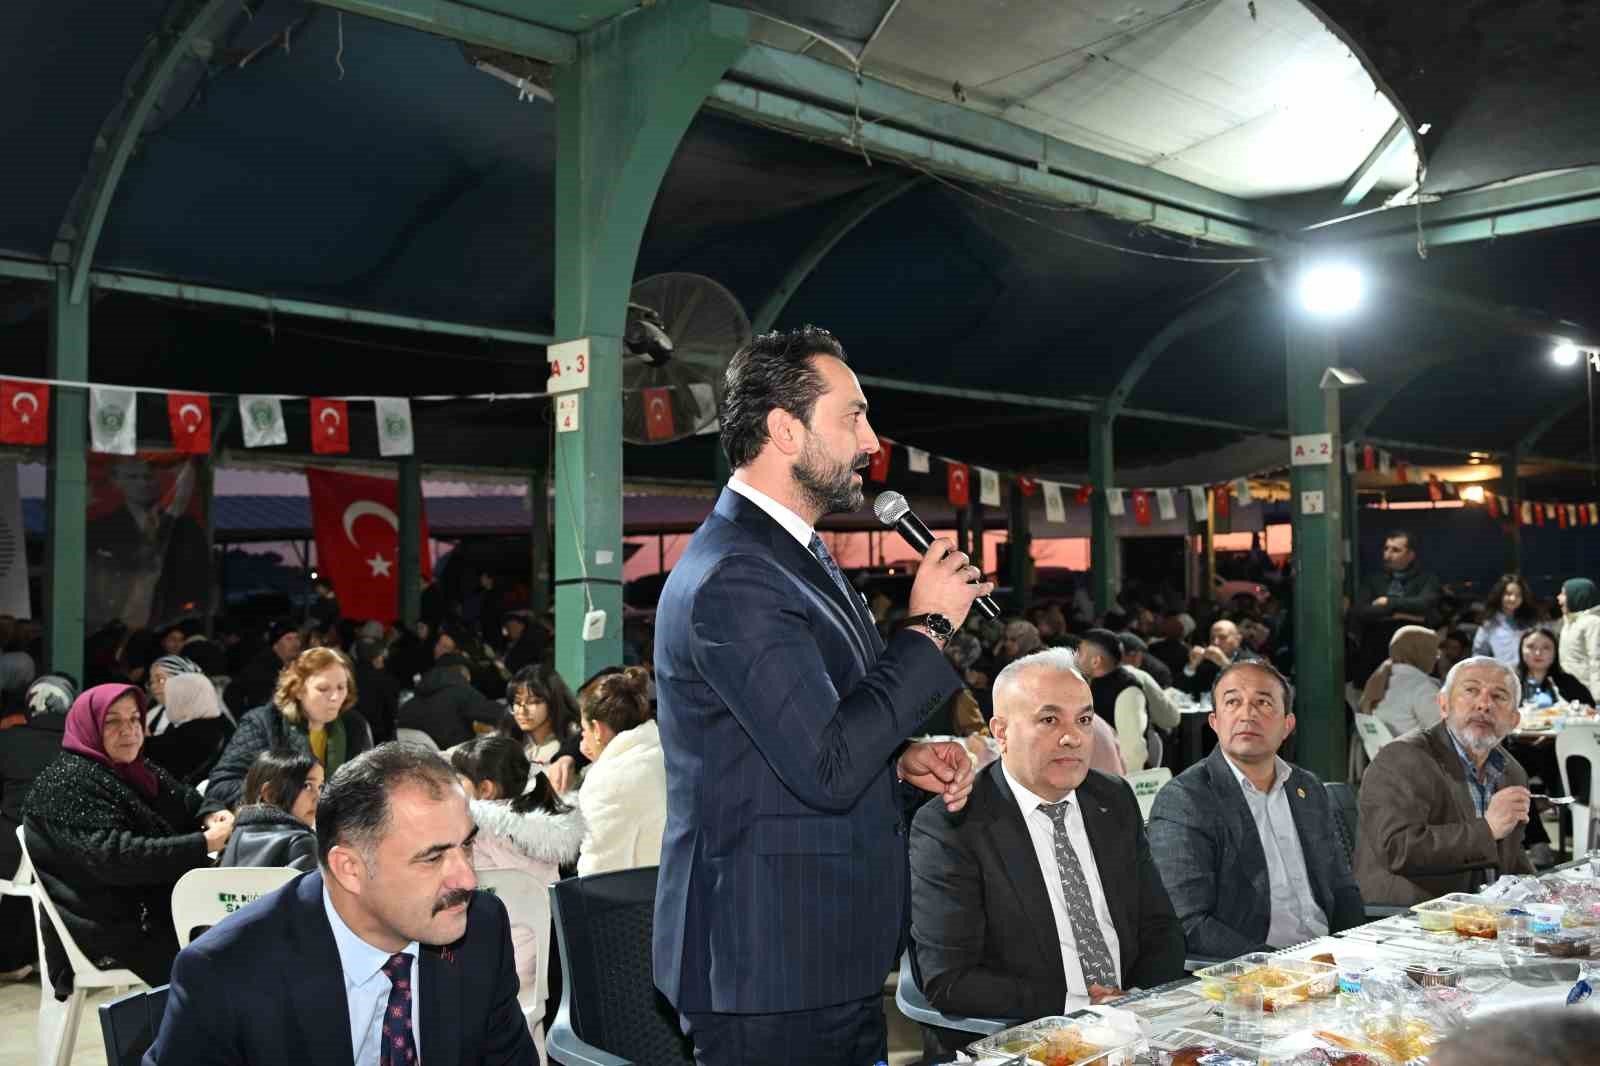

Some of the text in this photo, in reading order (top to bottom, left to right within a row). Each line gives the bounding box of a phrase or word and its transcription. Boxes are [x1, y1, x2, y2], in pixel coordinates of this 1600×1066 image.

[551, 359, 561, 377] A
[576, 354, 585, 373] 3
[563, 415, 571, 428] 4
[1295, 445, 1305, 457] A
[1320, 442, 1329, 455] 2
